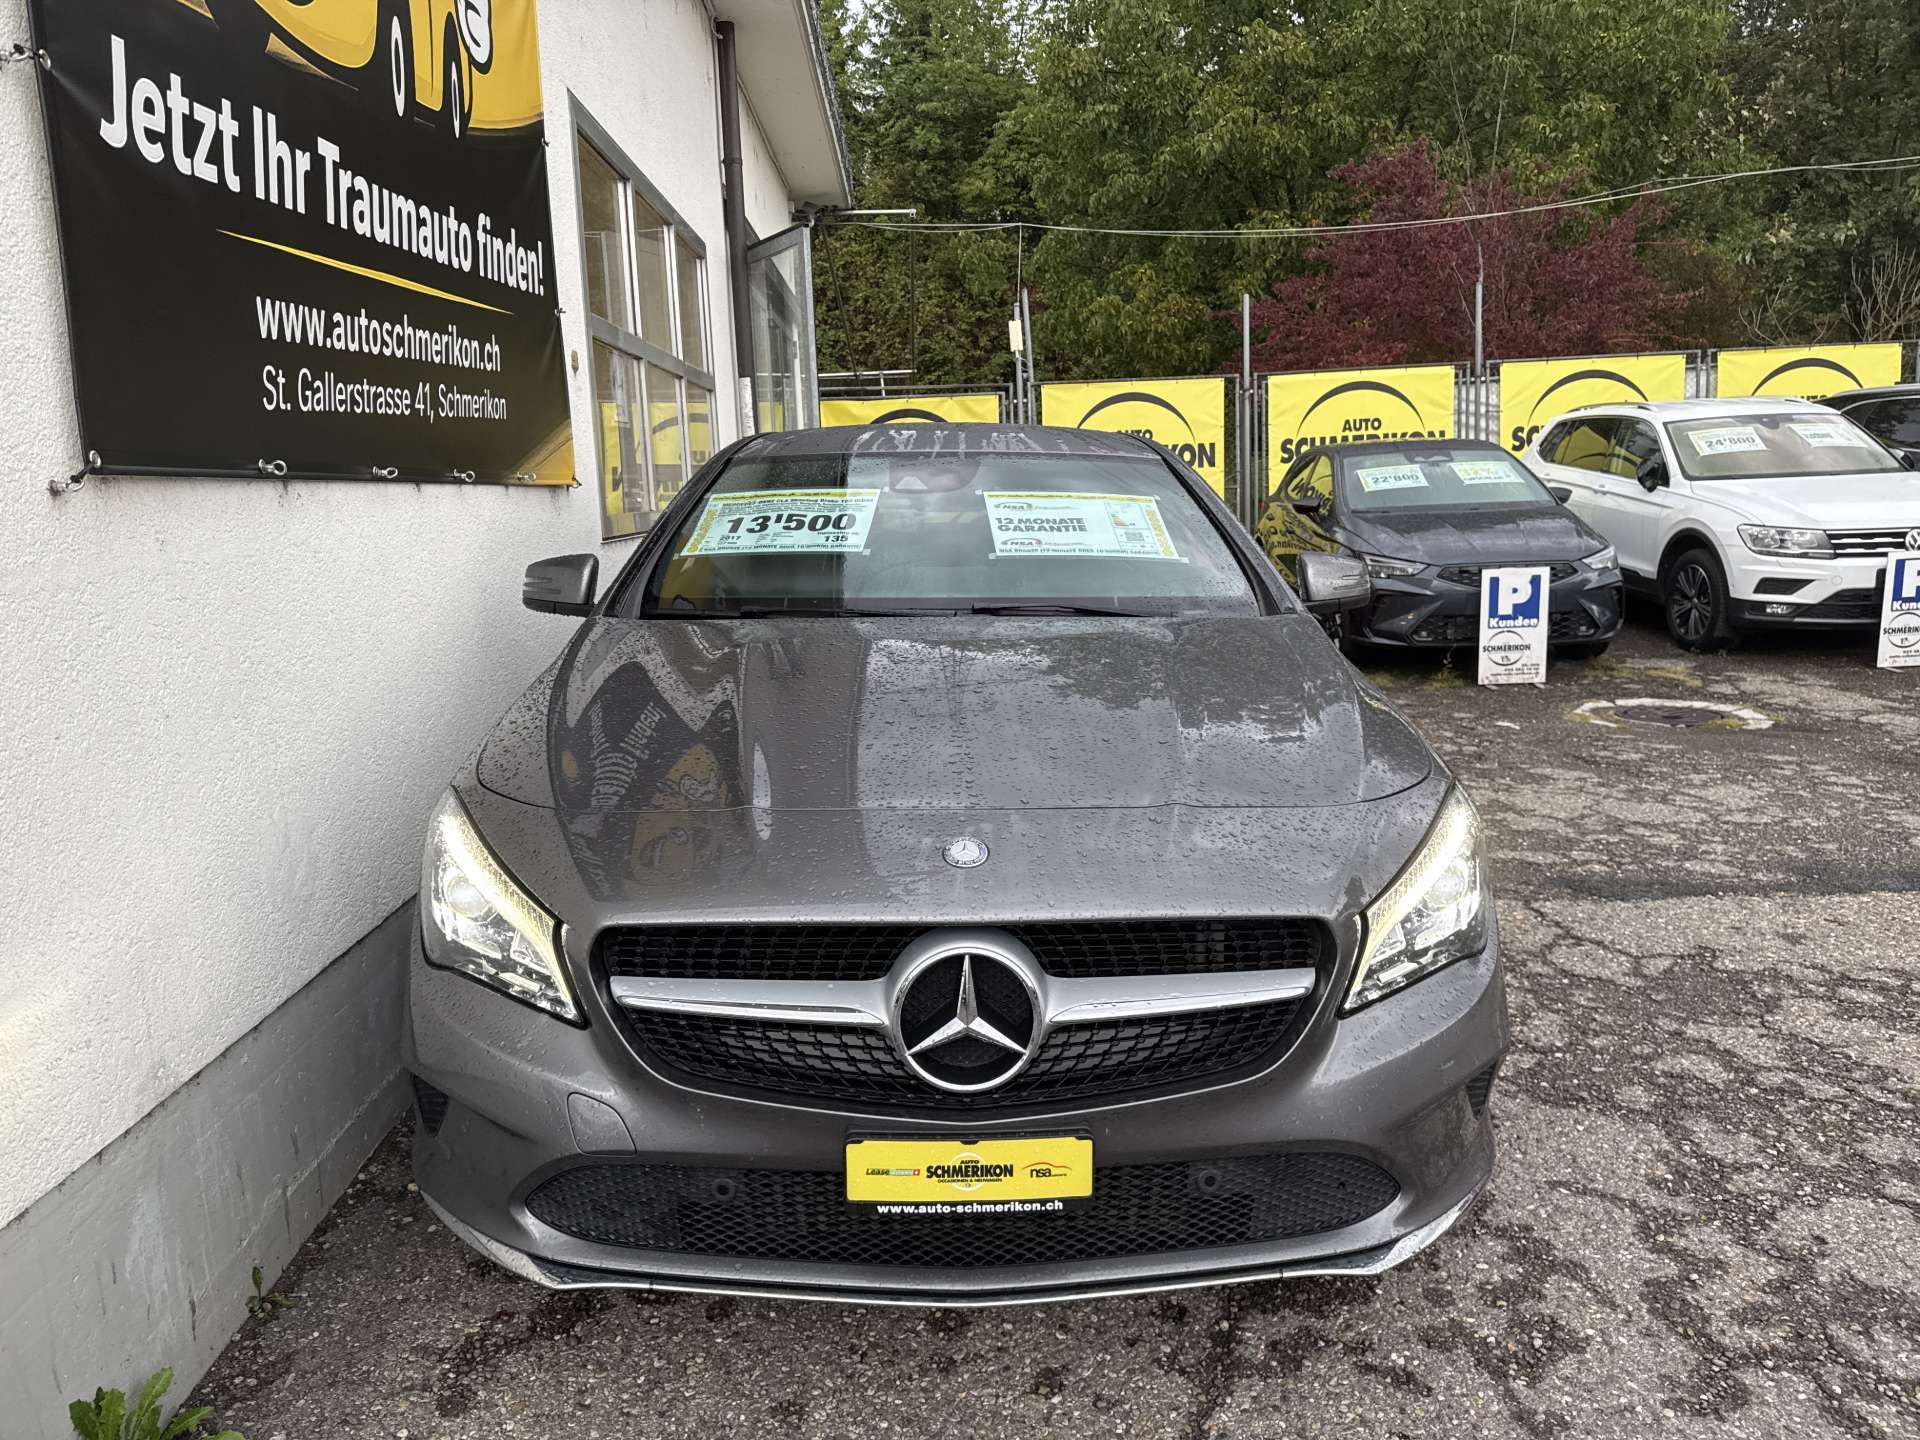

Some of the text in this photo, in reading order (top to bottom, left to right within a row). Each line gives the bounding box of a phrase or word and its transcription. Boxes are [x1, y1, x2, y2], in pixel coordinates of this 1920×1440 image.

[100, 34, 545, 297] Jetzt Ihr Traumauto finden!
[256, 296, 501, 372] www.autoschmerikon.ch
[262, 365, 507, 424] St. Gallerstrasse 41, Schmerikon
[1342, 417, 1382, 432] AUTO
[727, 513, 857, 534] 13'500
[996, 517, 1086, 525] 12 MONATE
[997, 525, 1088, 533] GARANTIE
[1892, 600, 1920, 610] Kun
[1489, 616, 1539, 629] Kunden
[1882, 625, 1920, 635] SCHMERIK
[1482, 643, 1532, 653] SCHMERIKON
[926, 1164, 1014, 1179] SCHMERIKON
[1030, 1168, 1052, 1178] nsa
[877, 1200, 1063, 1213] www.auto-schmerikon.ch
